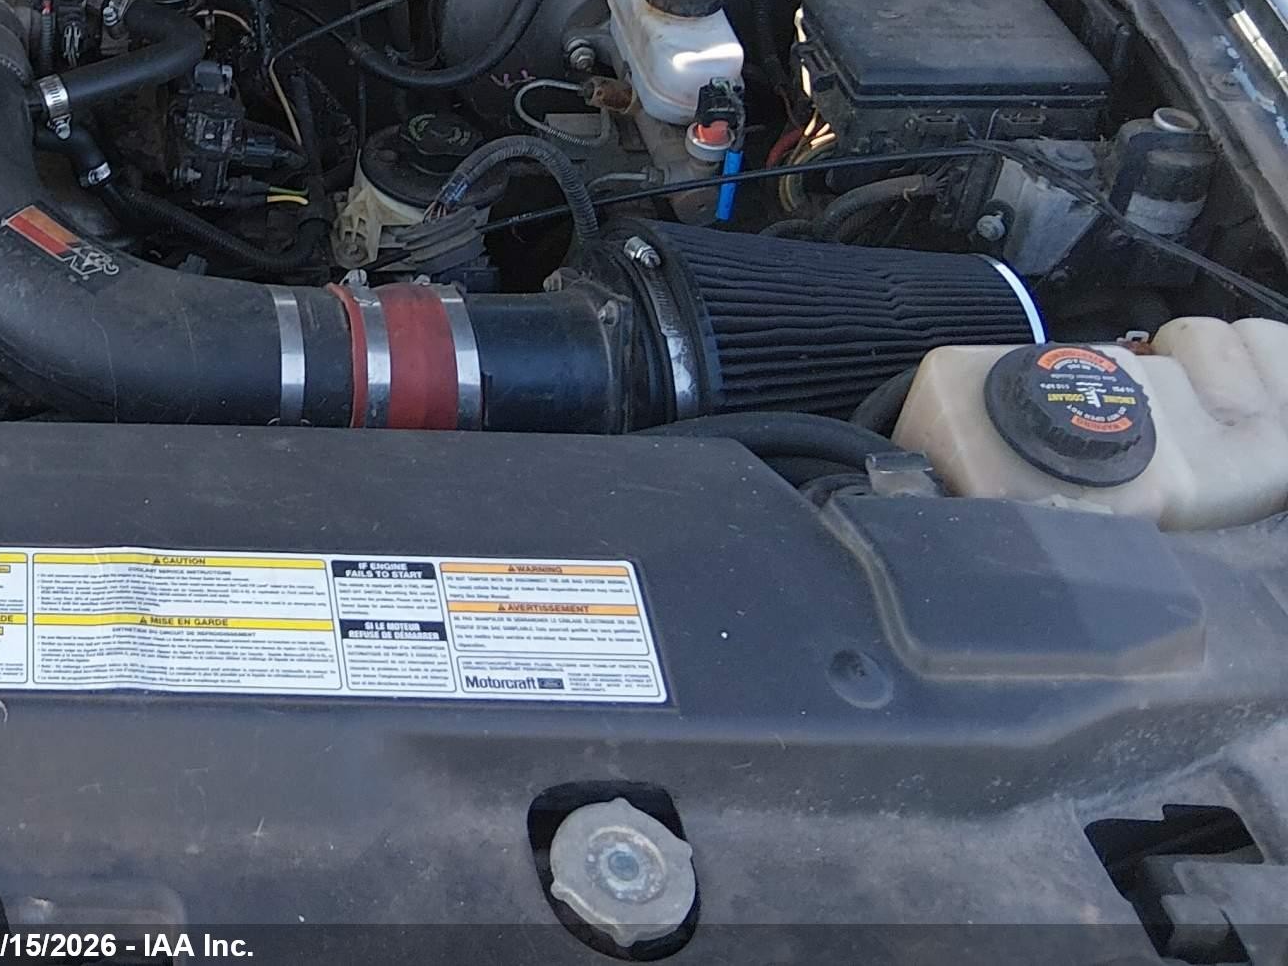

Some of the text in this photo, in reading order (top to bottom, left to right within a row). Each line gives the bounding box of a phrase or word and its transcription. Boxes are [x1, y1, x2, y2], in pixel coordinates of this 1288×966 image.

[162, 555, 207, 565] CAUTION
[369, 563, 408, 571] ENGINE
[516, 565, 563, 574] WARNING
[345, 570, 374, 578] FAILS
[391, 571, 423, 579] START
[507, 604, 590, 613] AVERTISSEMENT
[150, 617, 175, 625] MISE
[177, 618, 192, 626] EN
[364, 622, 421, 631] SI LE MOTEUR
[348, 630, 380, 639] REFUSE
[381, 631, 394, 640] DE
[464, 675, 537, 690] Motorcraft
